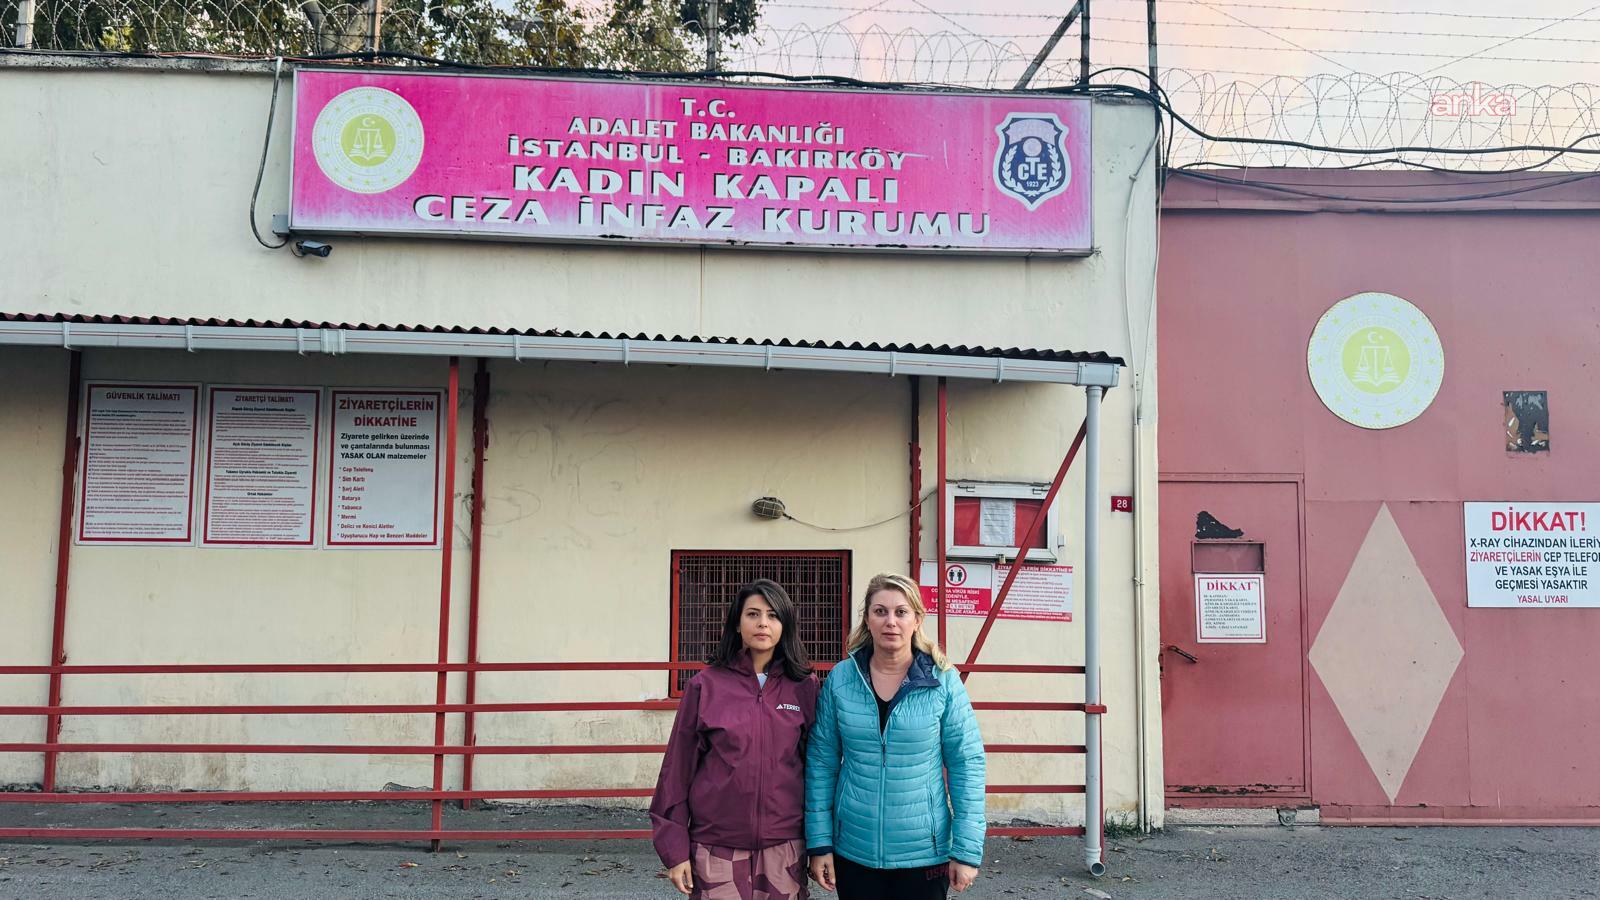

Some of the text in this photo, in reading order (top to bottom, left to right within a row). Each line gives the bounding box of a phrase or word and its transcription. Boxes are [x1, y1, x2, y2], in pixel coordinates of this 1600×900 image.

[680, 97, 736, 118] T.C.
[567, 116, 844, 145] ADALET BAKANLIĞI
[508, 133, 684, 163] İSTANBUL
[727, 146, 906, 170] BAKIRKÖY
[1018, 157, 1047, 180] CTE
[513, 164, 898, 203] KADIN KAPALI
[413, 194, 990, 238] CEZA İNFAZ KURUMU
[106, 391, 180, 401] GÜVENLİK TALİMATI
[235, 394, 294, 403] ZİYARETÇİ TALİMATI
[339, 397, 434, 412] ZİYARETÇİLERİN
[354, 414, 417, 427] DİKKATİNE
[371, 433, 399, 441] gelirken
[1116, 500, 1127, 508] 28
[1491, 506, 1586, 531] DİKKAT!
[1470, 538, 1500, 548] X-RAY
[1503, 536, 1567, 548] CİHAZINDAN
[1470, 550, 1541, 564] ZİYARETÇİLERİN
[1544, 551, 1561, 562] CEP
[1495, 564, 1588, 578] VE YASAK EŞYA İLE
[1206, 579, 1252, 591] DİKKAT
[1495, 577, 1588, 591] GEÇMESİ YASAKTIR
[1517, 595, 1568, 604] YASAL UYARI
